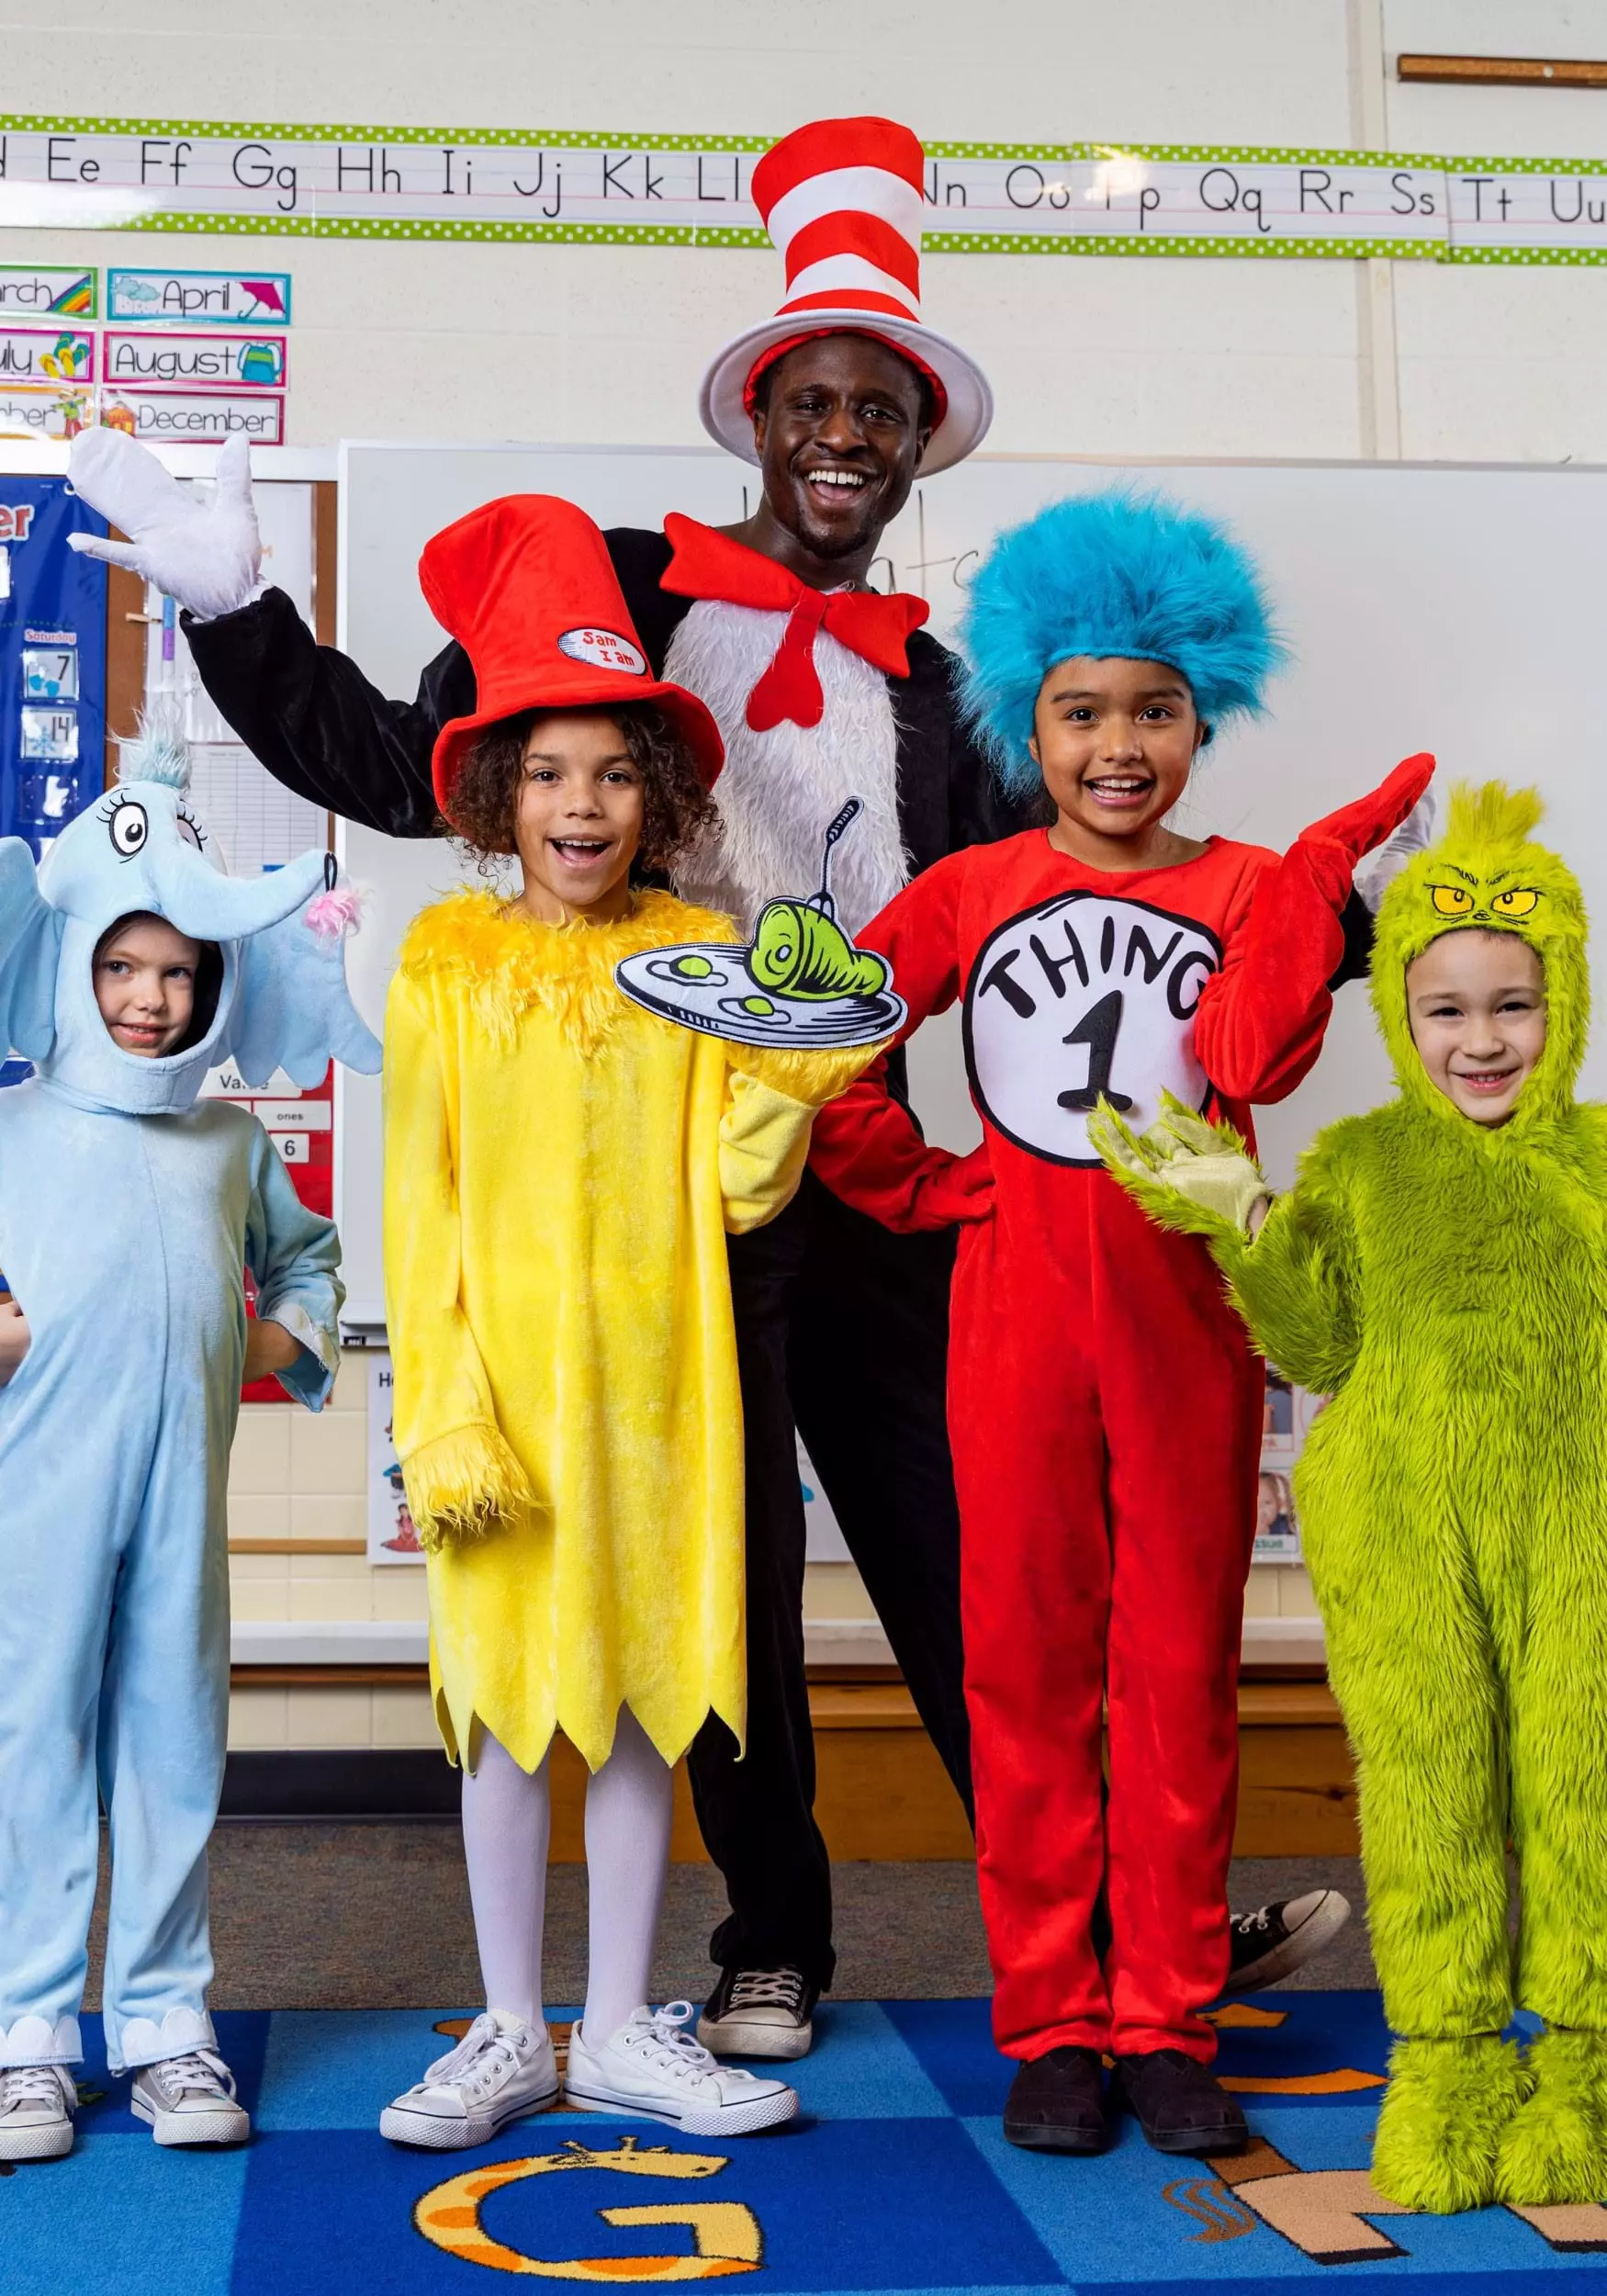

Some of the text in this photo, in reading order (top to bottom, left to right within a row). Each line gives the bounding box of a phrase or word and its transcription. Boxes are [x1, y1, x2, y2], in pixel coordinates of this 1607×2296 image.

[48, 137, 100, 182] Ee
[141, 141, 192, 186] Ff
[232, 144, 297, 210] Gg
[338, 147, 401, 193] Hh
[442, 150, 471, 195] Ii
[513, 152, 561, 218] Jj
[603, 154, 664, 199] Kk
[698, 156, 739, 201] Ll
[1006, 164, 1070, 209] Oo
[1199, 168, 1271, 232] Qq
[1299, 170, 1354, 213] Rr
[1391, 173, 1434, 215] Ss
[1462, 178, 1511, 221] Tt
[1551, 180, 1605, 223] Uu
[163, 280, 230, 317] April
[116, 343, 236, 380] August
[0, 401, 57, 427] ber
[139, 407, 275, 433] December
[582, 631, 617, 647] Sam
[57, 655, 71, 681] 7
[600, 649, 635, 667] I am
[51, 716, 70, 742] 14
[978, 916, 1216, 1021] THING
[1057, 989, 1133, 1112] 1
[276, 1112, 304, 1121] ones
[284, 1140, 296, 1156] 6
[411, 2136, 766, 2283] G
